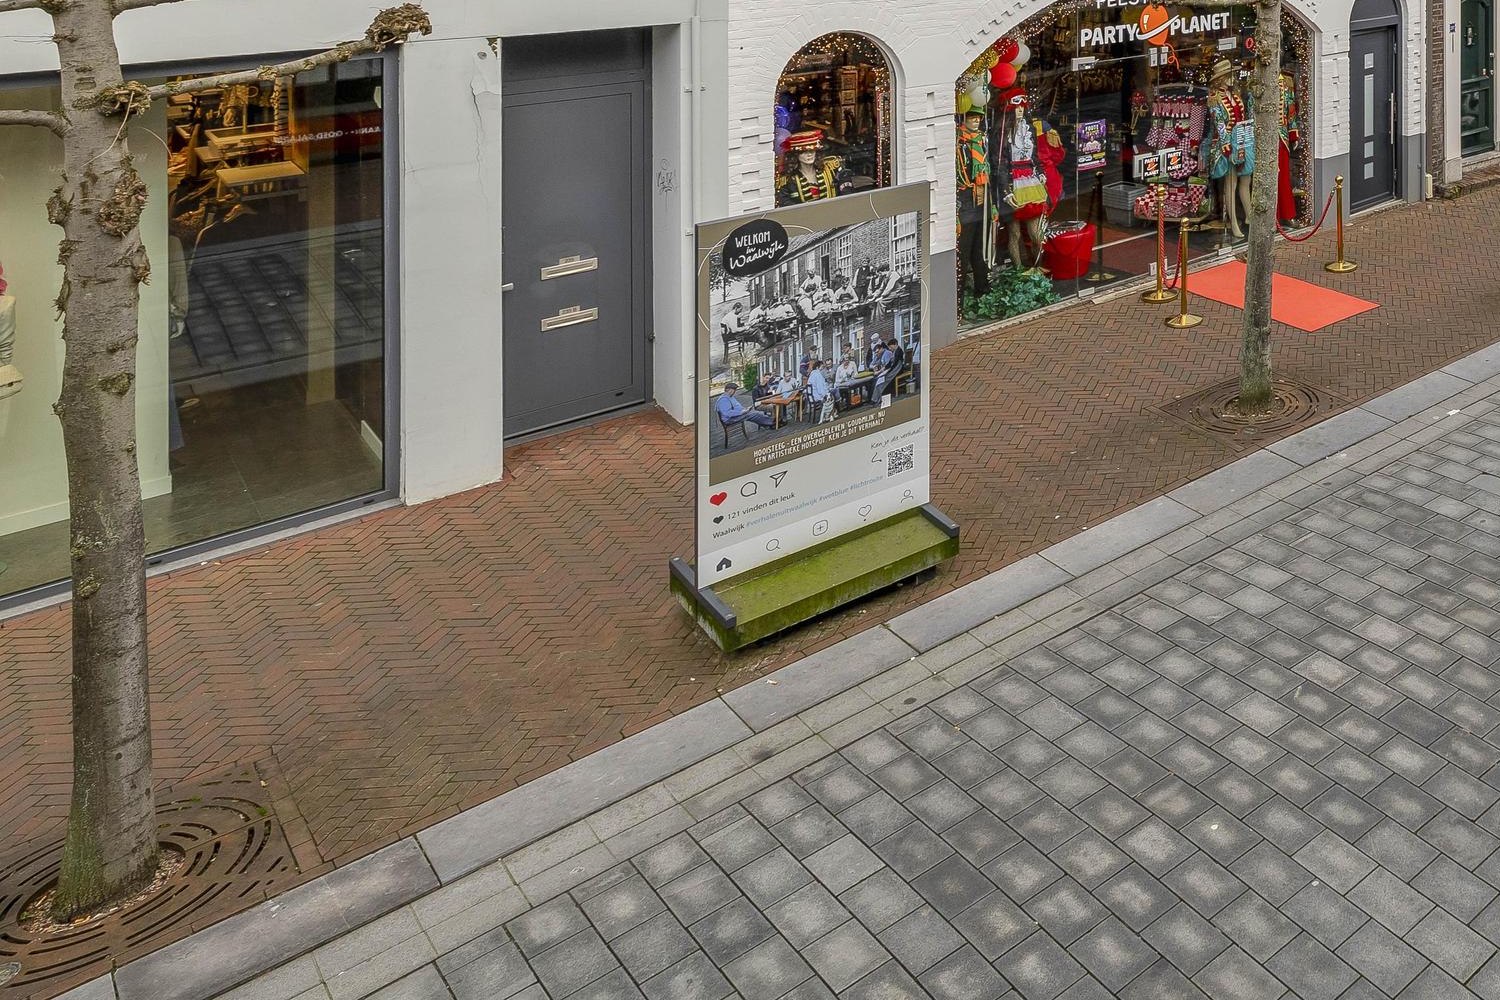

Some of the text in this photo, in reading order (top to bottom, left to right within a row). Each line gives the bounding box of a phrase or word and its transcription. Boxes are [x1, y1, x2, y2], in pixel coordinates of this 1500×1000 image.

[1080, 12, 1230, 48] PARTY PLANET
[1144, 156, 1159, 165] PARTY
[1167, 151, 1182, 159] PARTY
[1144, 169, 1159, 177] PLANET
[1167, 163, 1182, 171] PLANET
[735, 231, 771, 248] WELKOM
[729, 240, 785, 270] Waalwijk
[746, 246, 756, 254] in
[753, 442, 786, 458] HOOISTEEG
[791, 436, 802, 446] EEN
[802, 423, 845, 442] OVERGEBLEVEN
[755, 456, 767, 465] EEN
[767, 444, 800, 462] ARTISTIEKE
[828, 432, 840, 441] KEN
[841, 429, 847, 438] JE
[848, 426, 857, 435] DIT
[859, 417, 885, 432] VERHAAL?
[728, 492, 796, 519] 121 vinden dit leuk
[712, 523, 745, 539] Waalwijk
